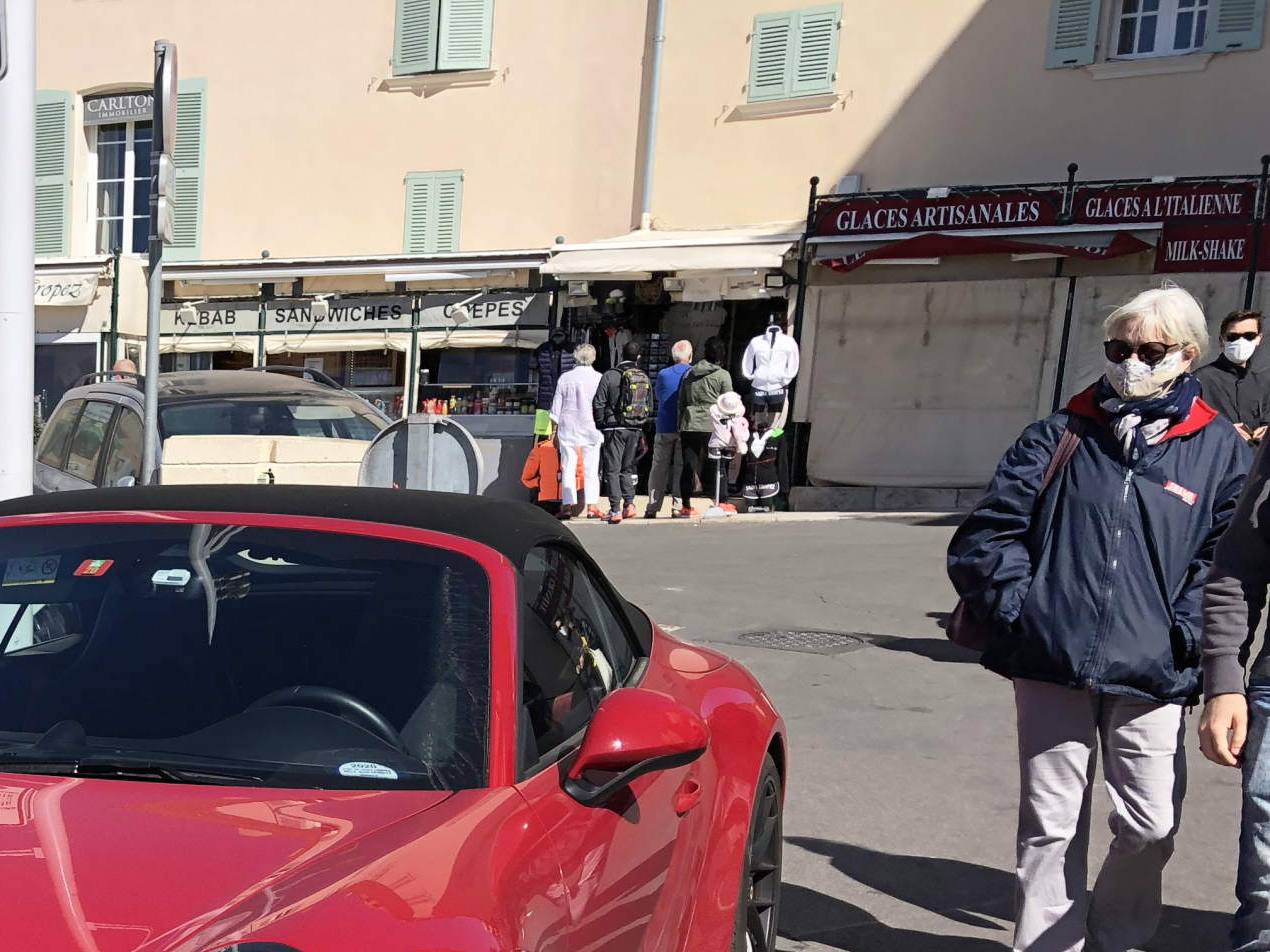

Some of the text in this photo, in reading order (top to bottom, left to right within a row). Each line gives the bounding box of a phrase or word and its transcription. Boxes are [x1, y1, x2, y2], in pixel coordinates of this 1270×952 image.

[98, 107, 148, 118] IMMOBILIER
[836, 200, 1040, 231] GLACES ARTISANALES
[1085, 197, 1140, 218] GLACES
[1141, 199, 1151, 217] A
[1164, 238, 1246, 262] MILK-SHAKE
[33, 279, 83, 302] ropez
[174, 310, 236, 326] KBAB
[443, 301, 524, 319] CEPES
